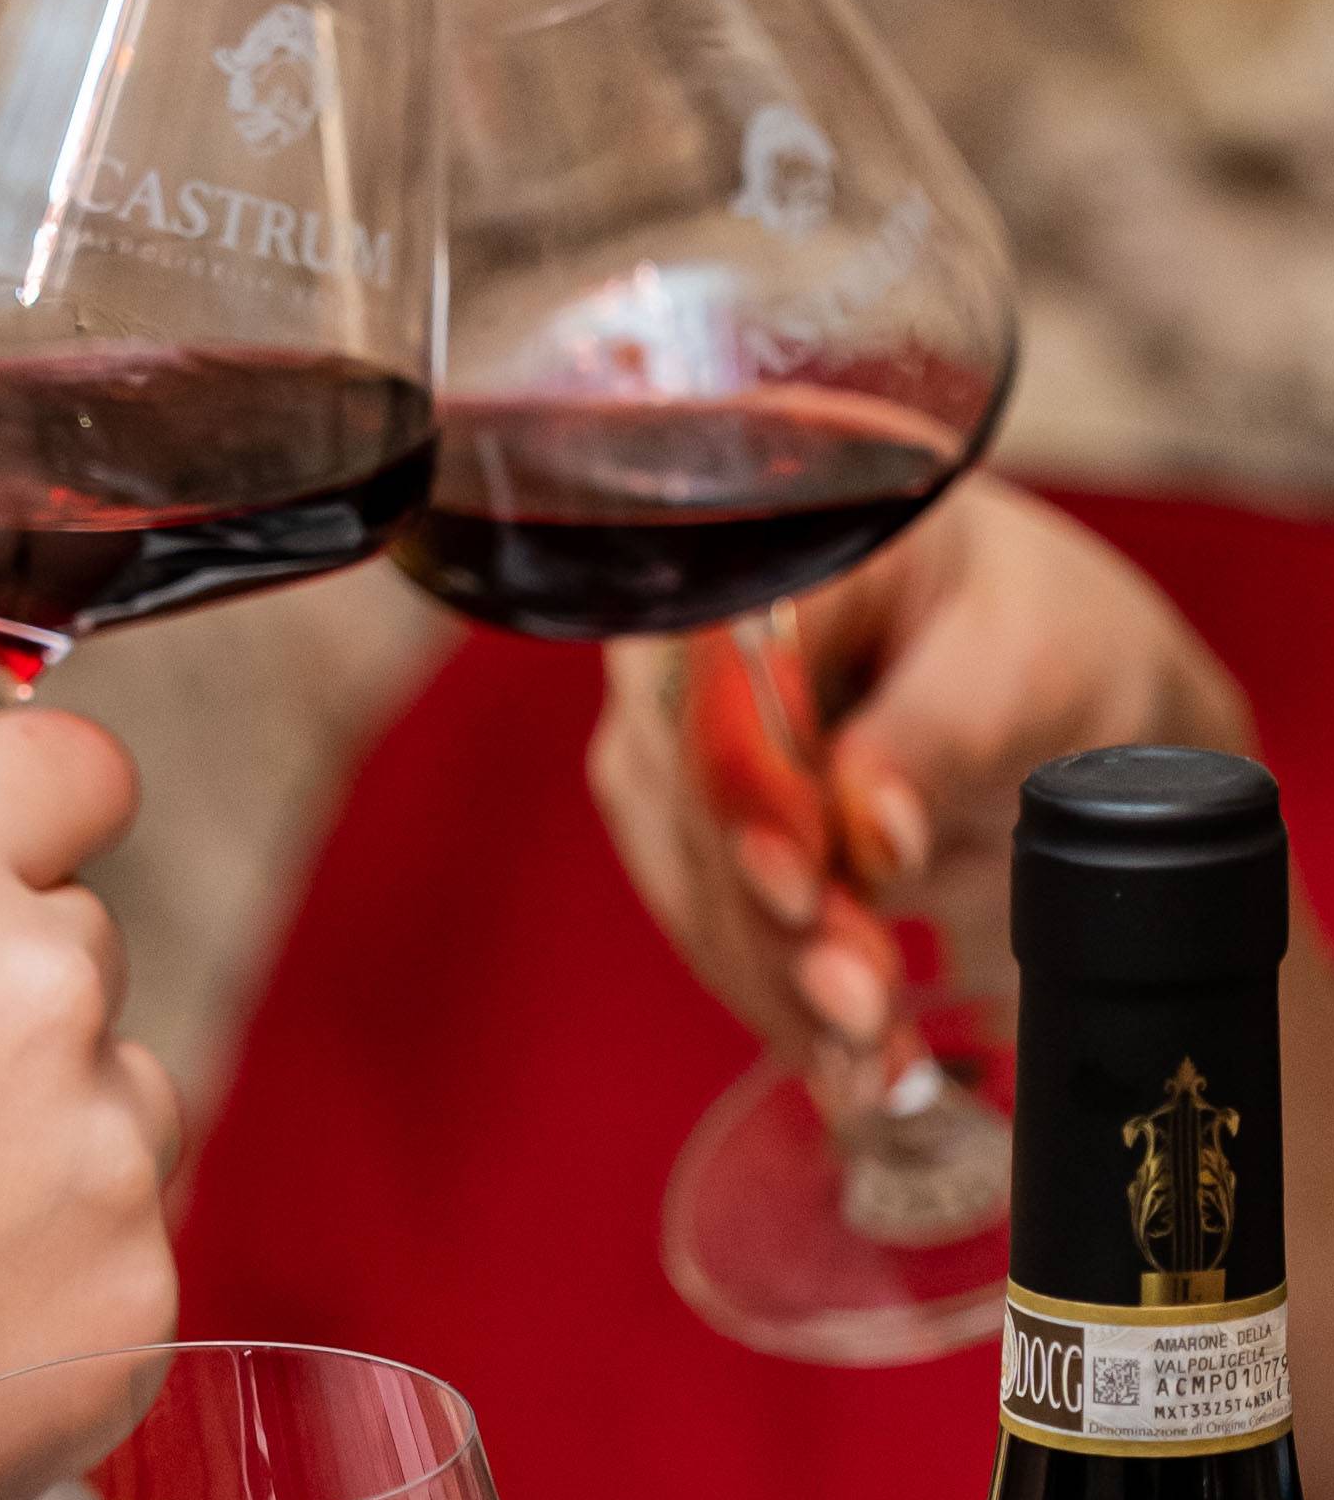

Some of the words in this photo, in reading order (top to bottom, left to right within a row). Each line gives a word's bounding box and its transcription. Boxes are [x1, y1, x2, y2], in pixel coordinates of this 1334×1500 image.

[72, 154, 393, 288] CASTRUM
[1154, 1333, 1228, 1352] AMARONE
[1237, 1324, 1272, 1346] DELLA
[1016, 1331, 1083, 1412] DOCG
[1155, 1346, 1265, 1374] VALPOLICELLA
[1088, 1421, 1188, 1438] Denominazione
[1192, 1419, 1203, 1435] di
